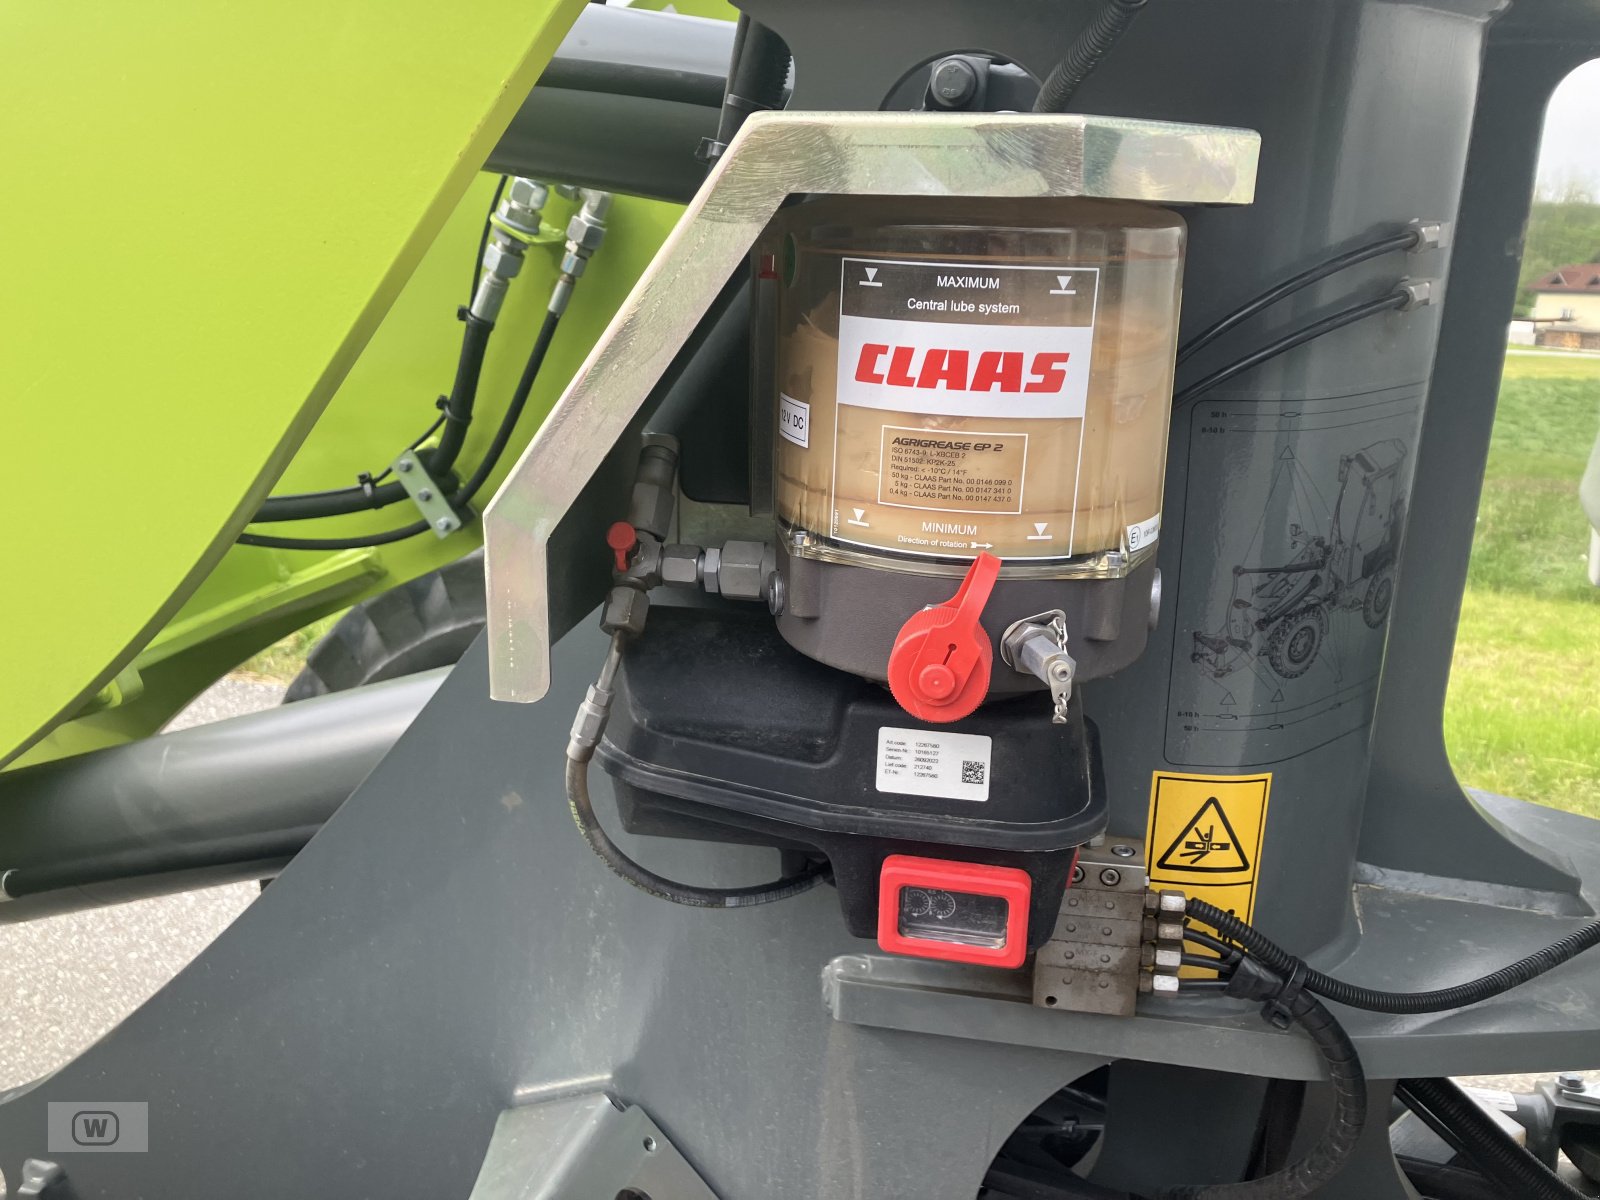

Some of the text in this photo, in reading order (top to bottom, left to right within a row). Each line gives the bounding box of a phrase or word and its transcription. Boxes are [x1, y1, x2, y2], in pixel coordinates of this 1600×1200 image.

[937, 276, 1000, 289] MAXIMUM
[907, 298, 1020, 316] Central lube system
[855, 343, 1070, 393] CLAAS
[794, 414, 804, 430] DC
[892, 437, 972, 450] AGRIGREASE
[993, 444, 1004, 452] 2
[891, 464, 920, 472] Required:
[922, 522, 977, 536] MINIMUM
[898, 535, 967, 548] Direction of rotation
